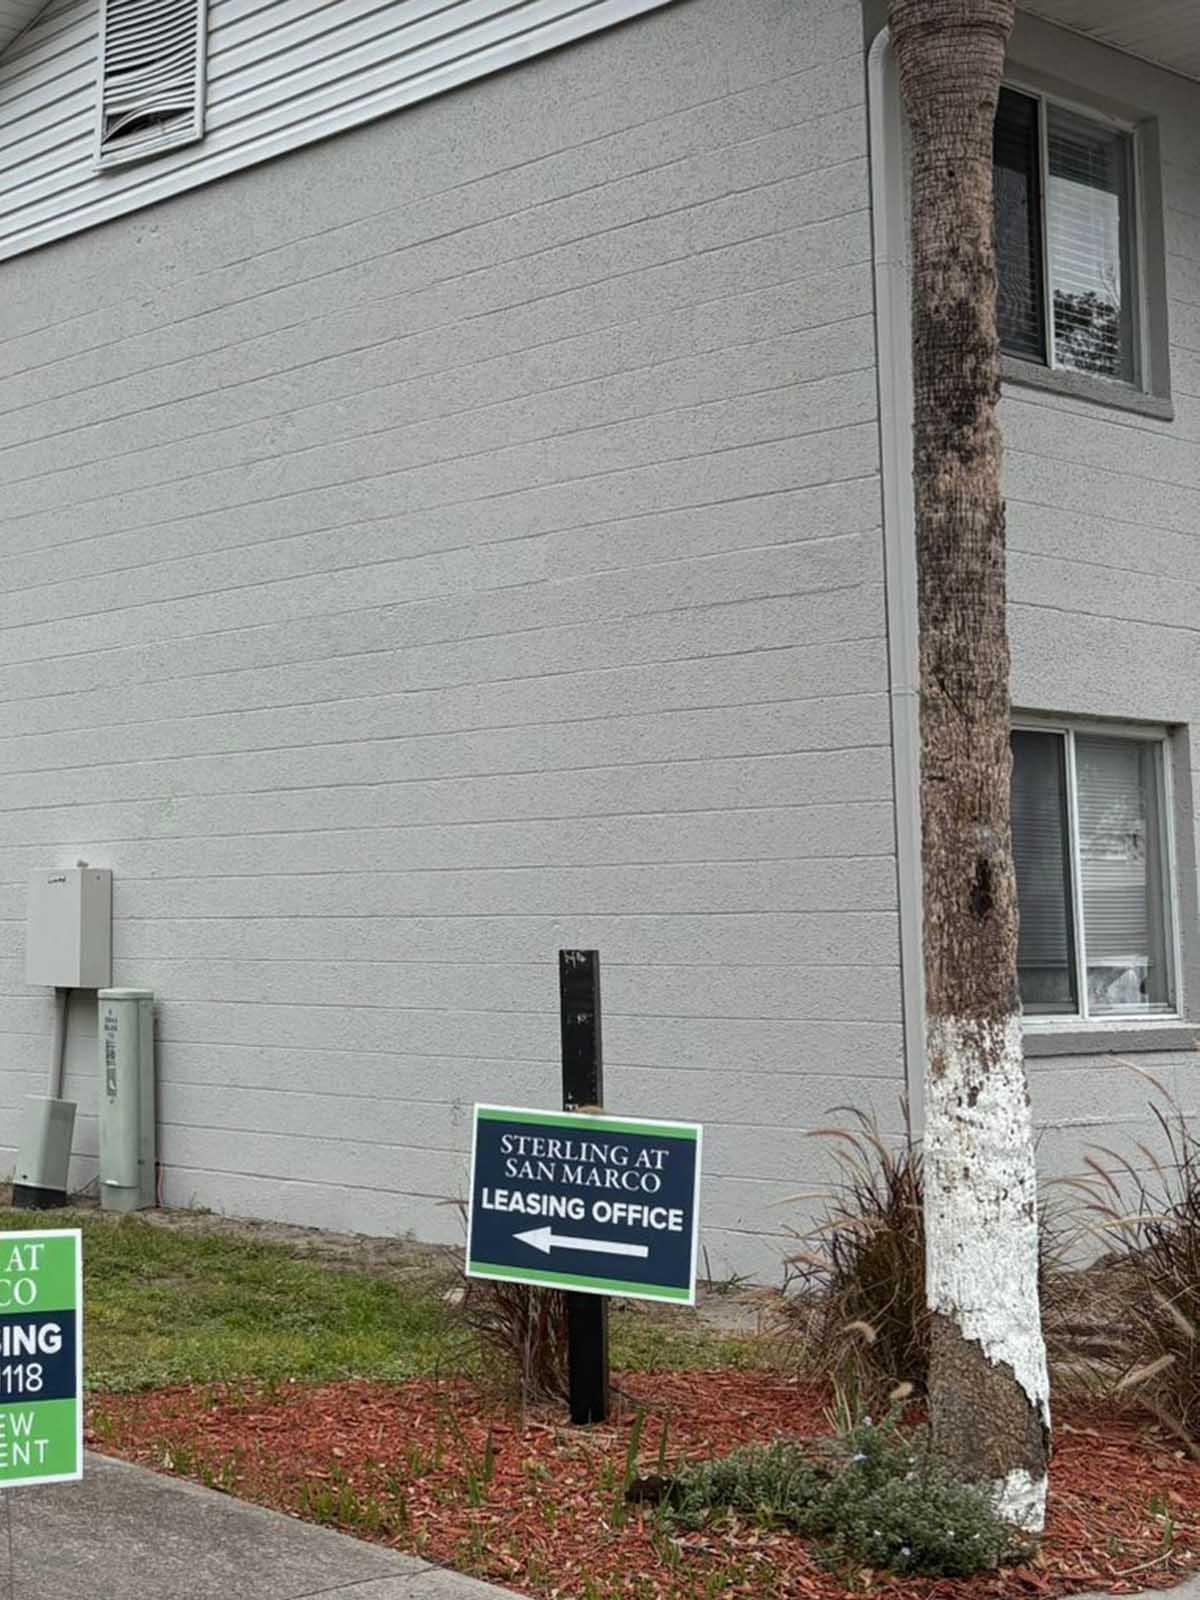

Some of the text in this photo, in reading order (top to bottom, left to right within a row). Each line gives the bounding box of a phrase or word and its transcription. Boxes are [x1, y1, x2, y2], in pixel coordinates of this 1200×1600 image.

[500, 1134, 670, 1170] STERLING AT
[505, 1157, 662, 1193] SAN MARCO
[481, 1187, 684, 1232] LEASING OFFICE
[6, 1243, 45, 1272] AT
